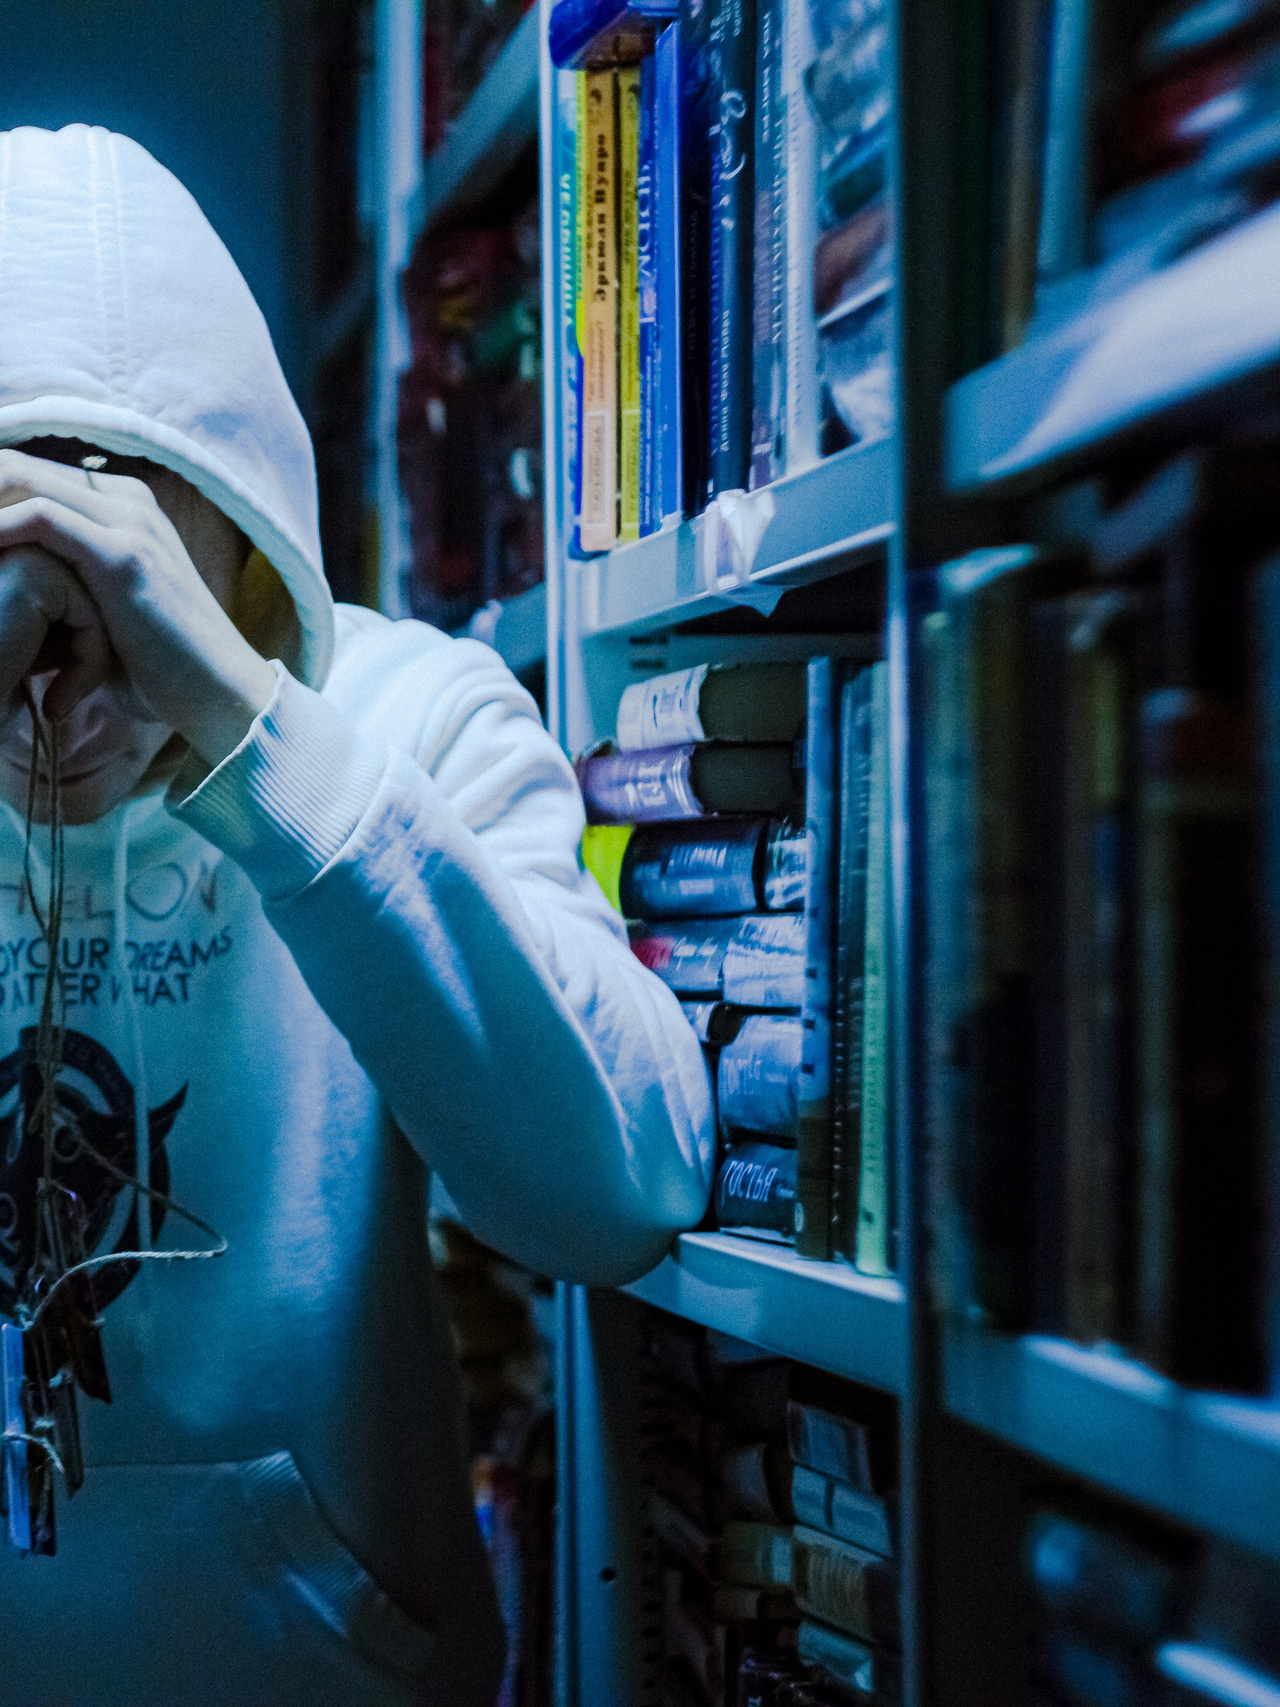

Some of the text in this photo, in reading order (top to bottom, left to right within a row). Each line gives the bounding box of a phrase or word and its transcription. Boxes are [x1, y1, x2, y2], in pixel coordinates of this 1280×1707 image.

[594, 133, 609, 204] Пуаро
[7, 936, 110, 972] YOUR
[721, 1159, 779, 1206] ГОСТЬЯ
